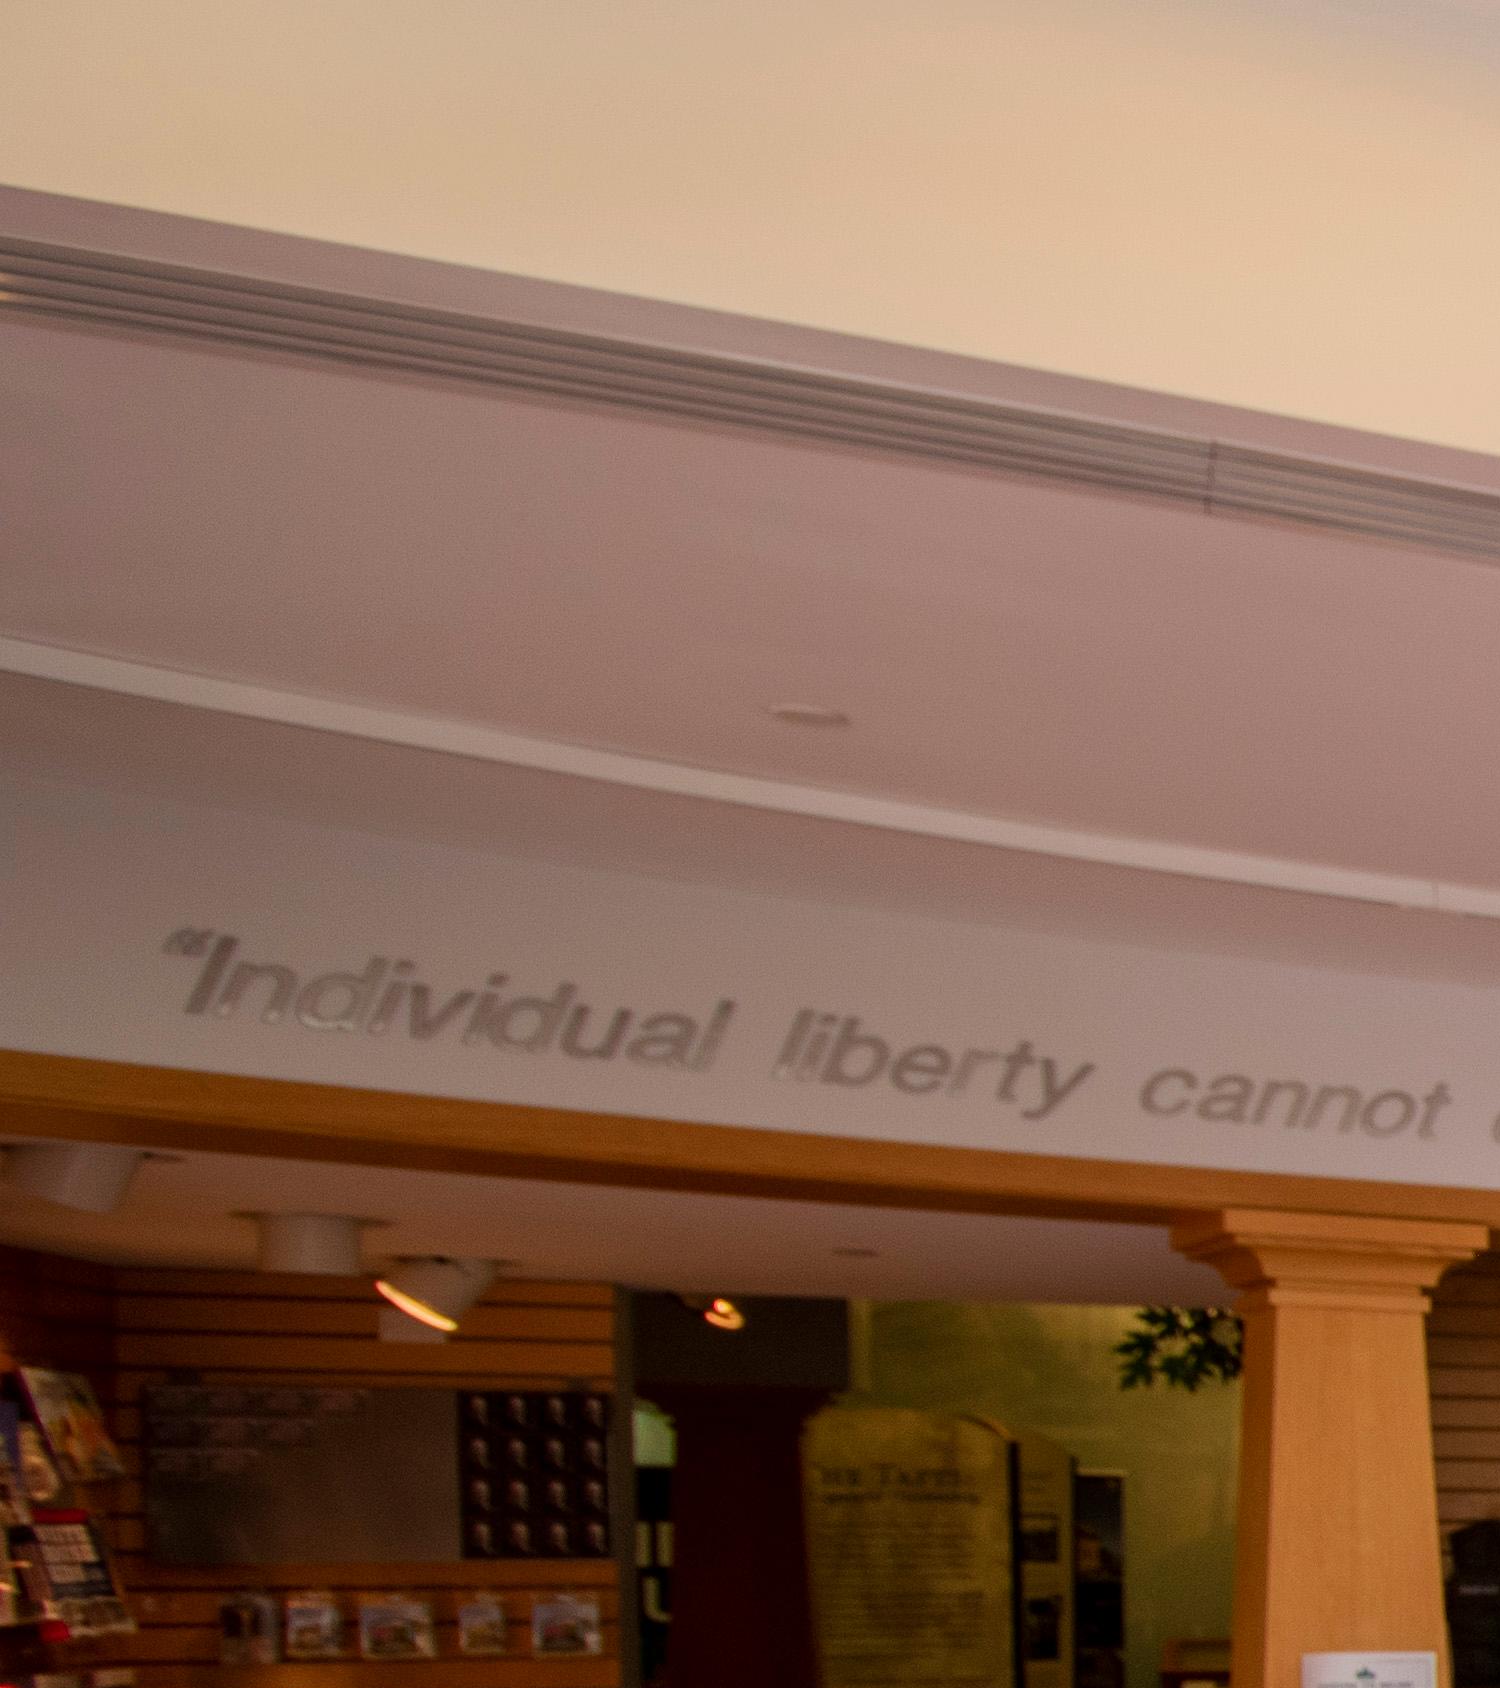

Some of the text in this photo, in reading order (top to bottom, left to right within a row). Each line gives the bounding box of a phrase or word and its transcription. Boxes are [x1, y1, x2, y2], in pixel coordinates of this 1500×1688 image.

[162, 924, 736, 1072] “Individual
[780, 1006, 1097, 1123] liberty
[1138, 1060, 1450, 1142] cannot
